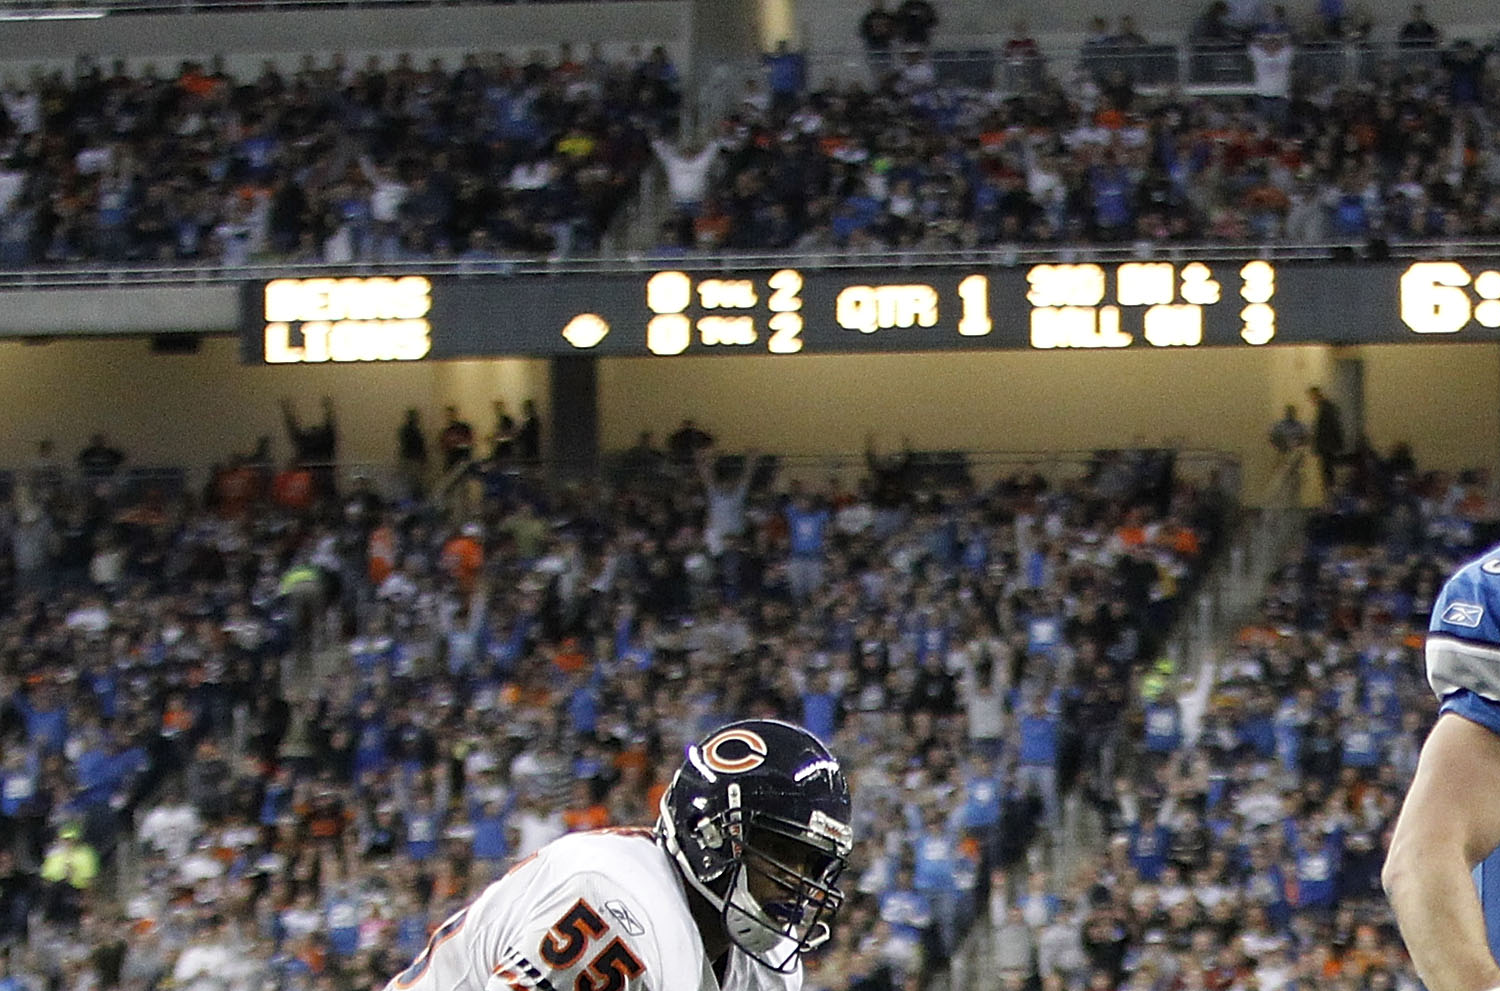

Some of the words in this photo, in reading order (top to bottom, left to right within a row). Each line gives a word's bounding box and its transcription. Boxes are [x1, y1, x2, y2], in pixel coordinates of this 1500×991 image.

[768, 269, 803, 312] 2
[836, 284, 939, 334] QTR
[958, 274, 992, 336] 1
[265, 320, 432, 363] LIONS
[768, 311, 803, 354] 2
